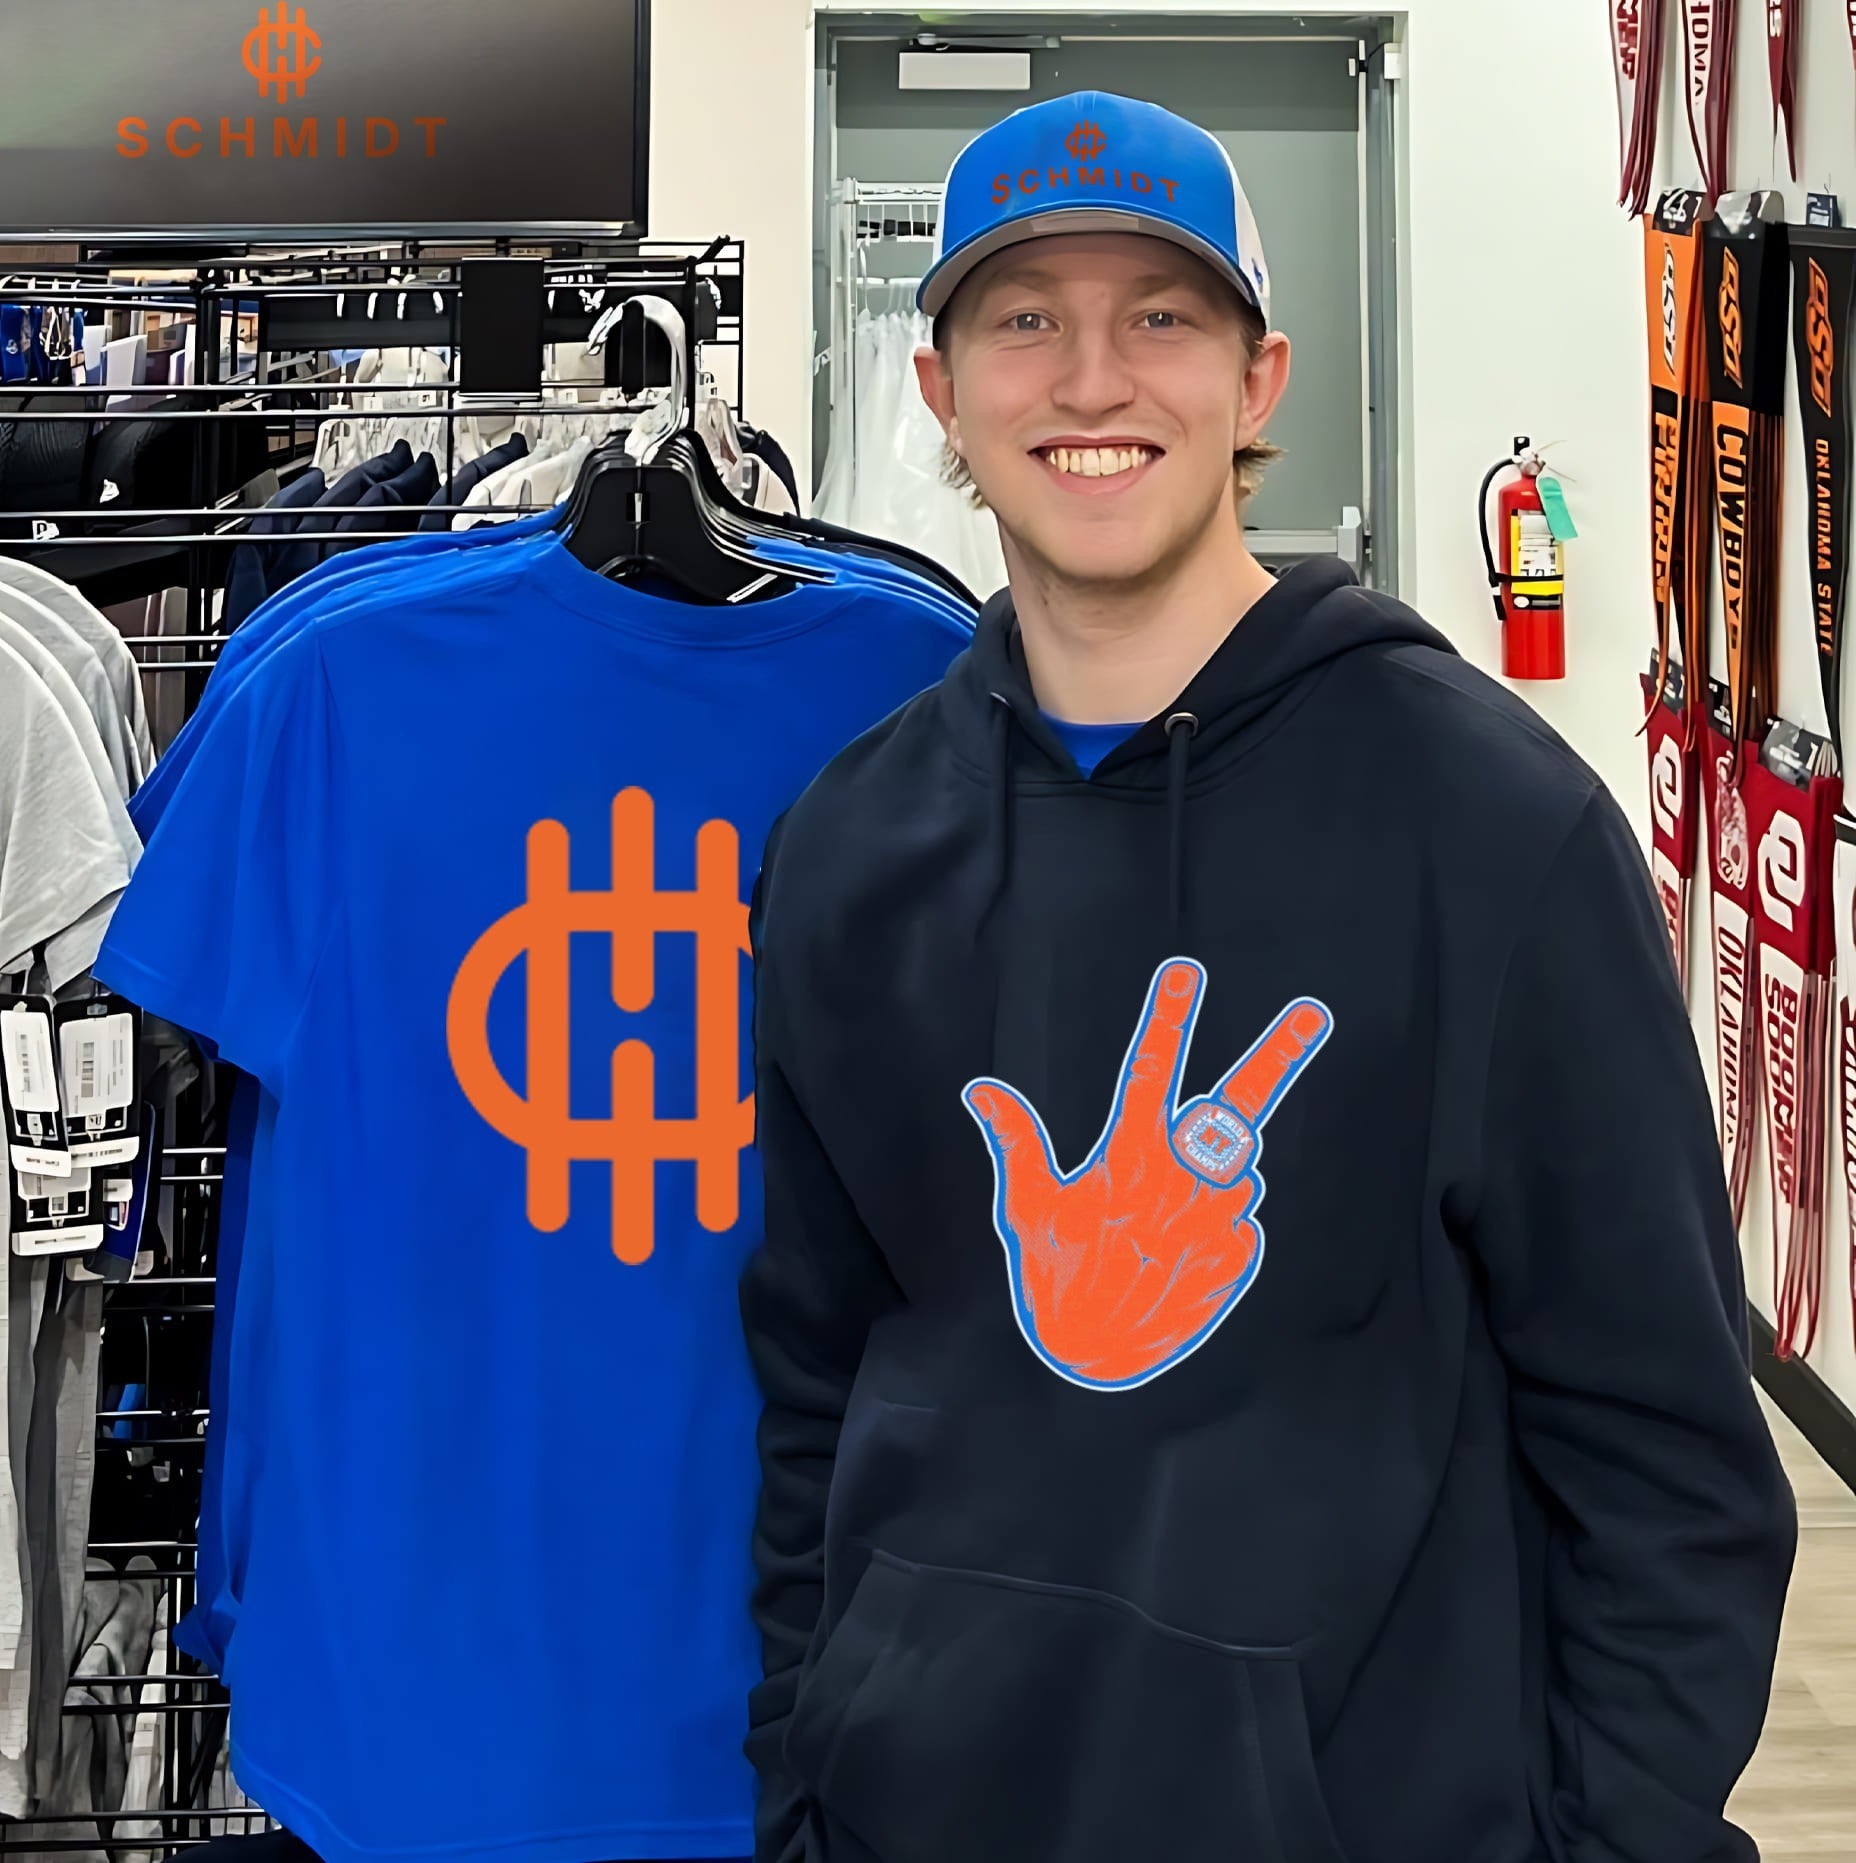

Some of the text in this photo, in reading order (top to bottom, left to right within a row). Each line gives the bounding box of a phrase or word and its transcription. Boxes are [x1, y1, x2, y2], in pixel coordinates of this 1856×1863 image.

[115, 116, 448, 158] SCHMIDT
[991, 167, 1179, 205] SCHMIDT
[1719, 246, 1743, 390] OSU
[1806, 256, 1833, 418] OSU
[1815, 438, 1833, 657] OKLAHOMA STATE
[1757, 809, 1806, 932] OU
[1718, 926, 1746, 1144] OKLAHOMA
[1185, 1143, 1216, 1172] CHAMPS
[1215, 1110, 1245, 1137] WORLD
